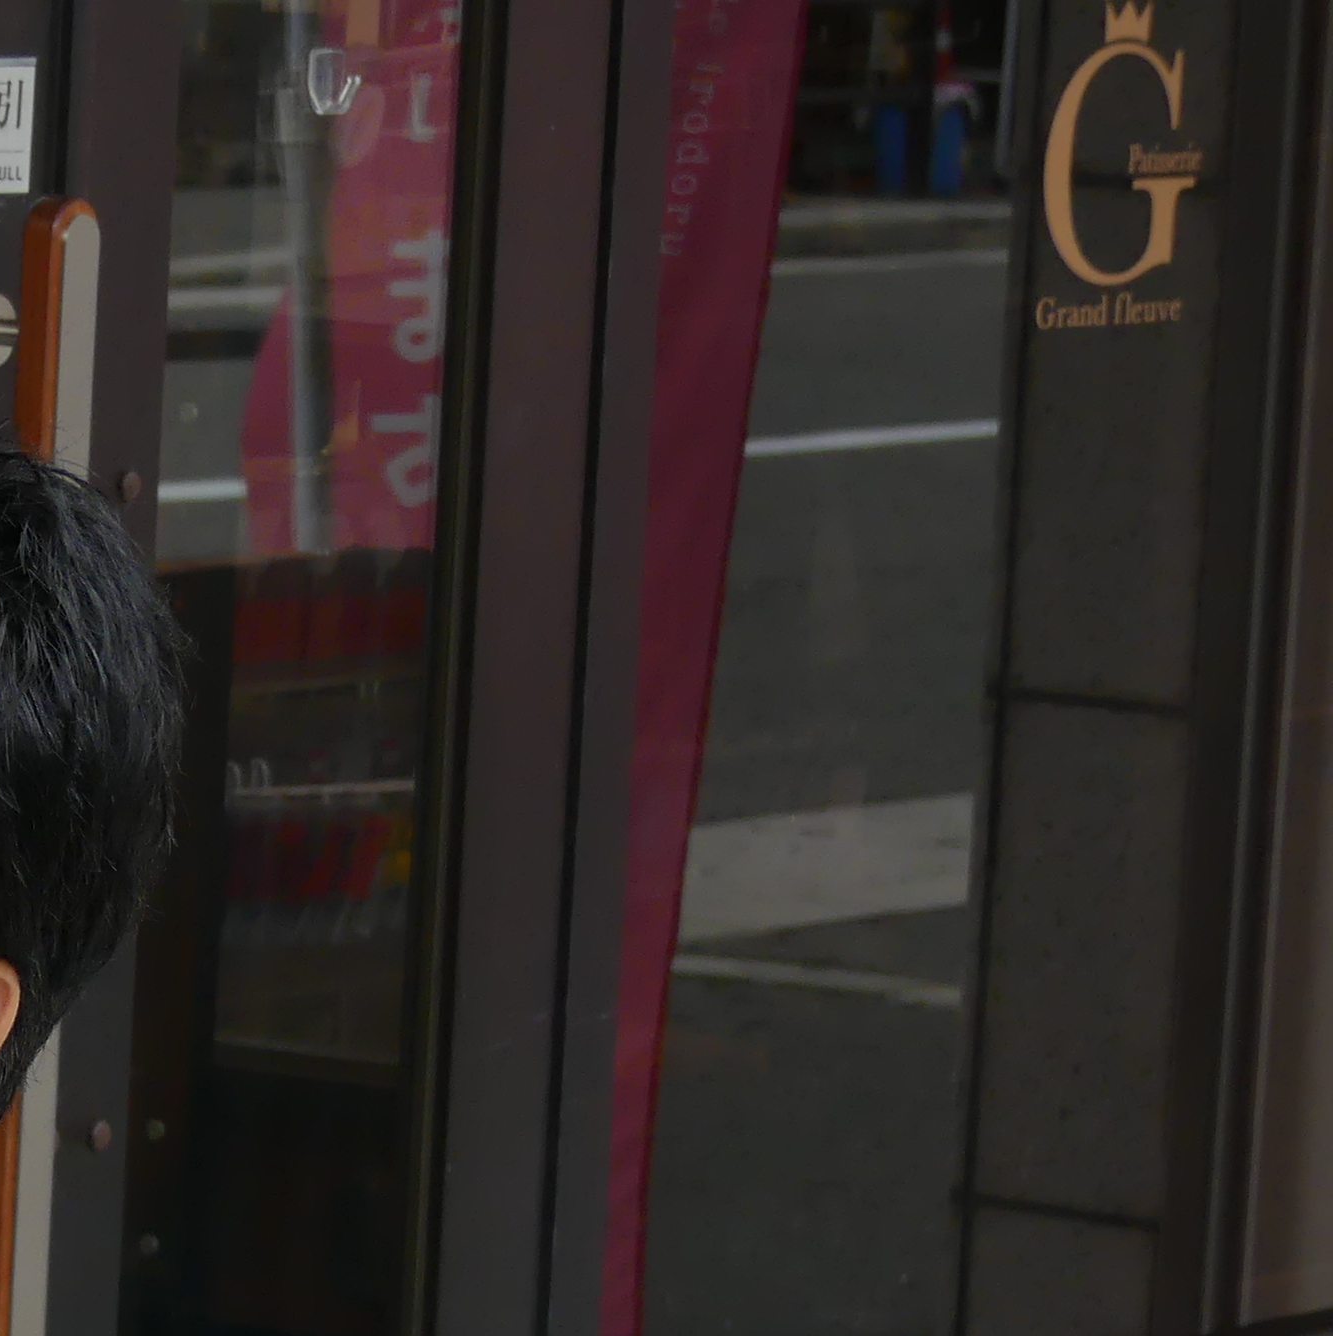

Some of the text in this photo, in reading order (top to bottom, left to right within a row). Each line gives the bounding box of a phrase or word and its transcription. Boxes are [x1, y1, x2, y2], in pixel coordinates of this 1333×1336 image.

[1044, 42, 1197, 286] G
[1129, 142, 1204, 174] Patisserie
[1036, 291, 1183, 330] Grand fleuve
